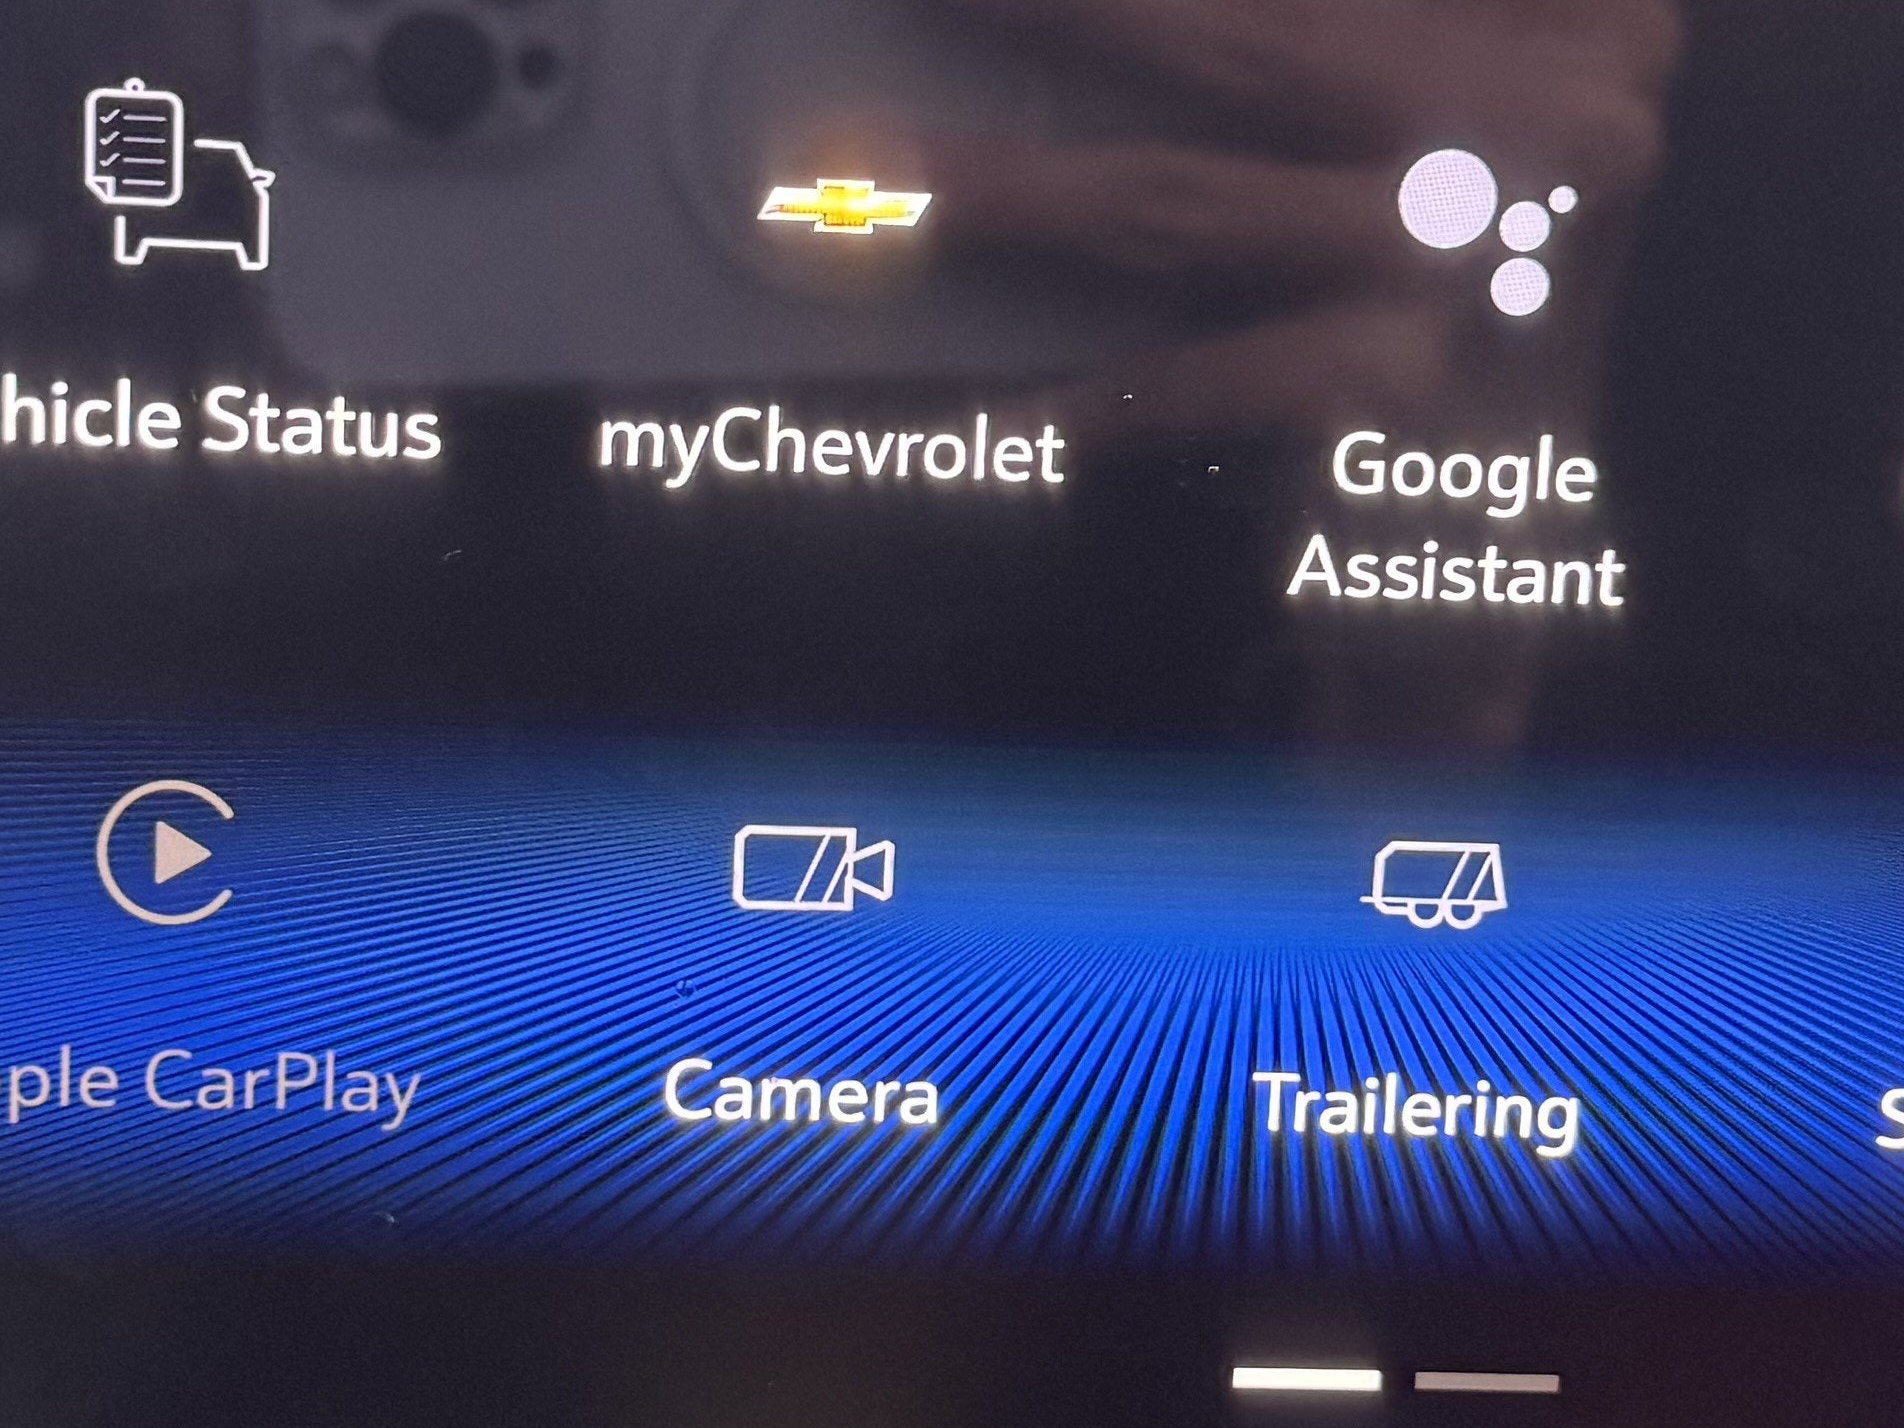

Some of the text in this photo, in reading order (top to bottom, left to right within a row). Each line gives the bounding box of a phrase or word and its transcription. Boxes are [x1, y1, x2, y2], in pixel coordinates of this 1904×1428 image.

[203, 390, 441, 461] Status
[597, 407, 1066, 490] myChevrolet
[1326, 427, 1601, 512] Google
[1284, 537, 1628, 612] Assistant
[143, 1047, 423, 1132] CarPlay
[661, 1057, 940, 1130] Camera
[1253, 1071, 1581, 1159] Trailering
